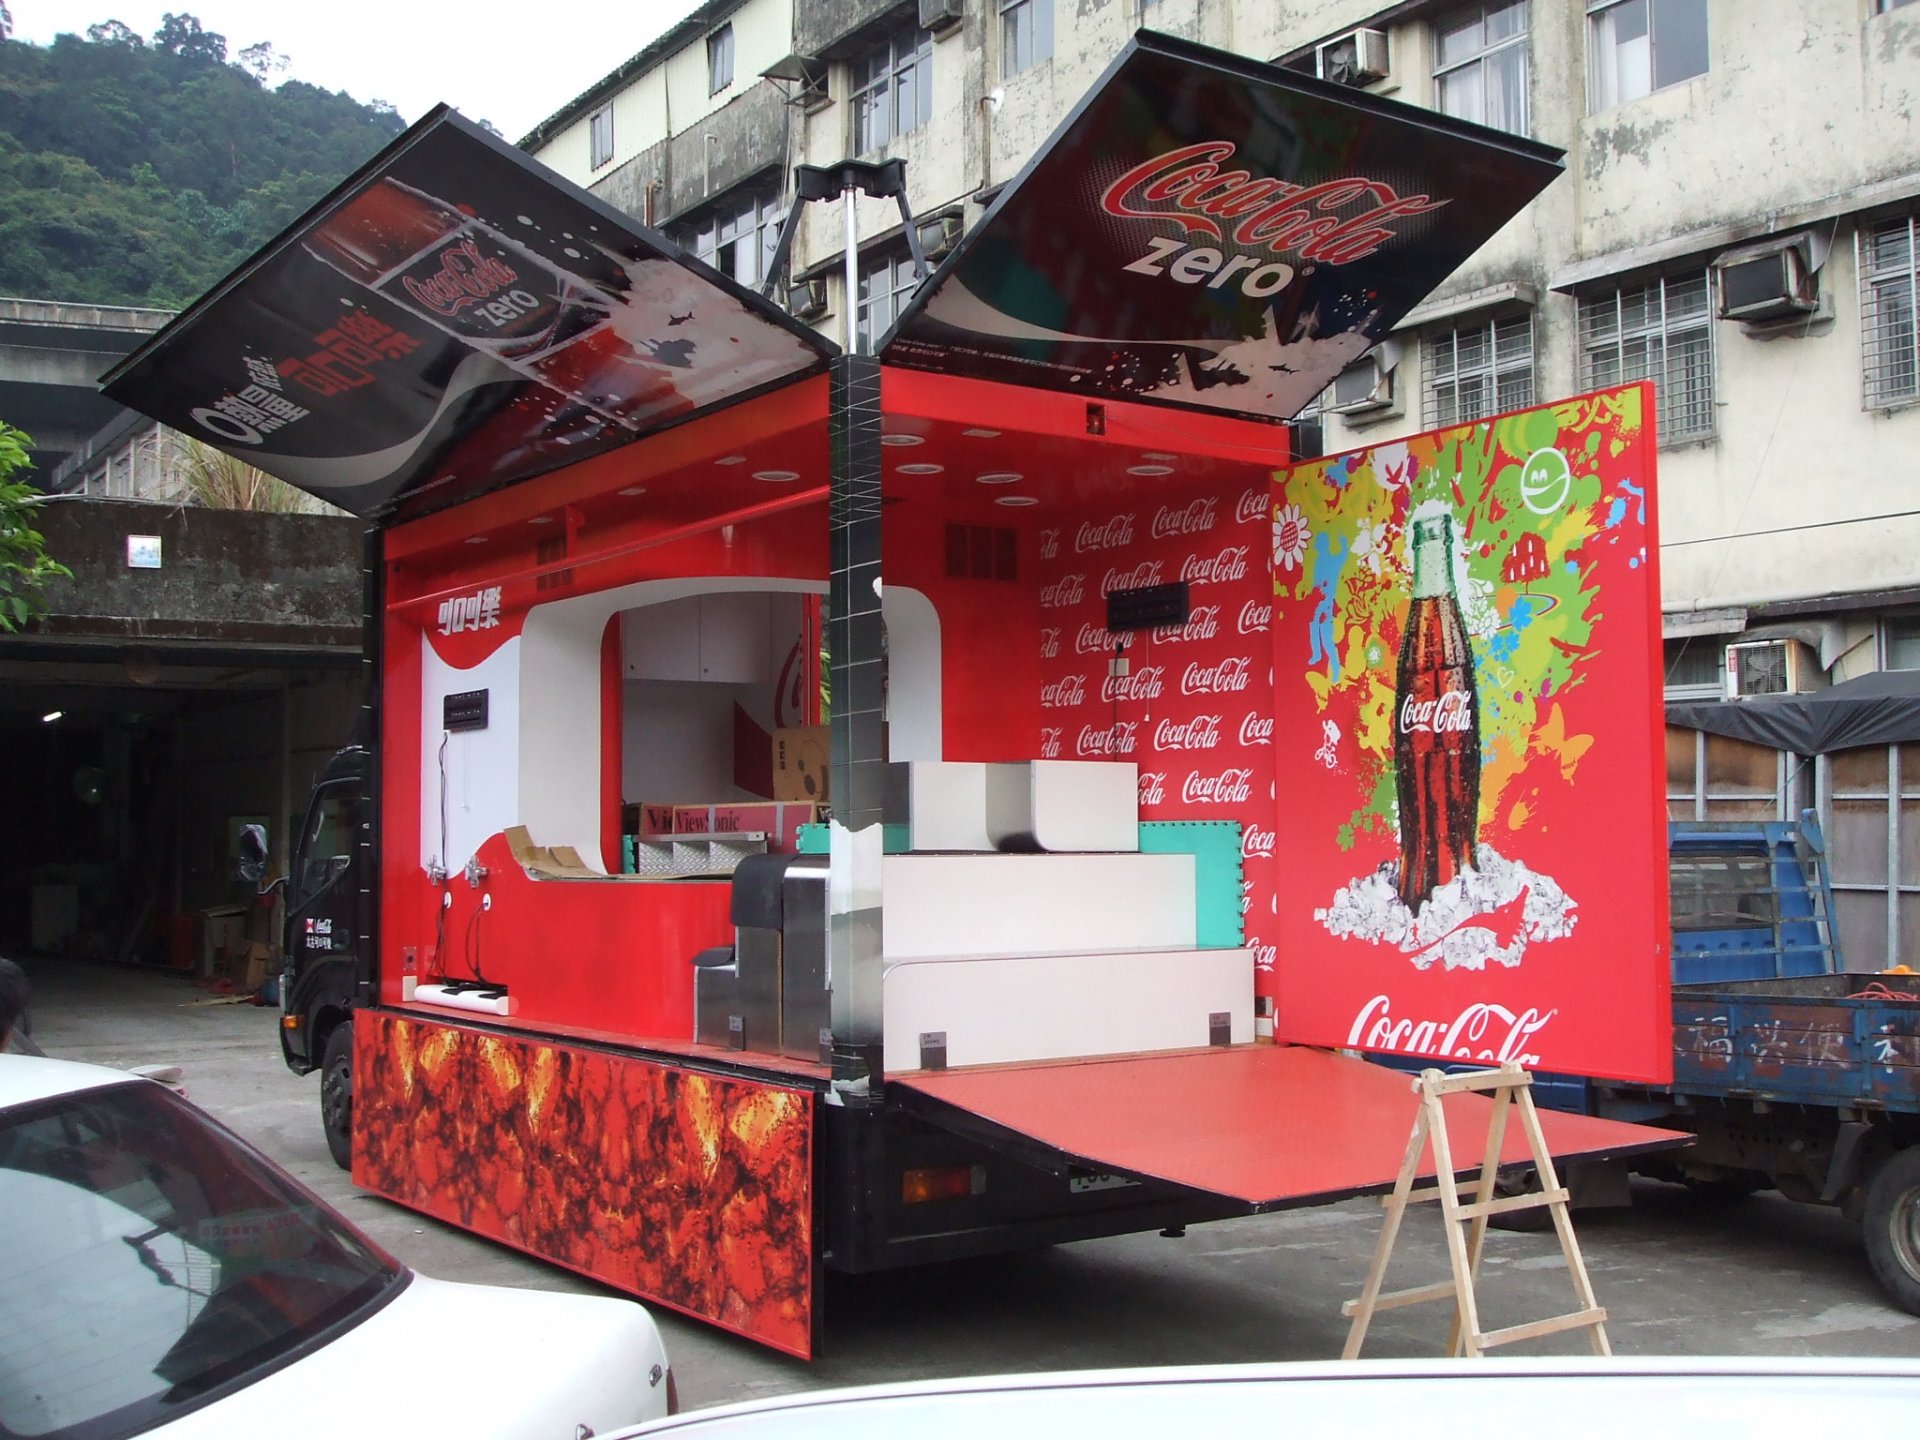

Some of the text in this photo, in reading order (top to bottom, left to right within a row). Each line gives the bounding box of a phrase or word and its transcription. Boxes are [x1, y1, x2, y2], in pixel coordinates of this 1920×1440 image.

[1101, 141, 1453, 266] Coca-Cola
[402, 240, 518, 317] Coca-Cola
[1122, 236, 1294, 298] zero
[473, 289, 540, 327] zero
[1075, 513, 1136, 553] Coca-Cola
[1152, 497, 1219, 539] Coca-Cola
[1180, 545, 1250, 586] Coca-Cola
[1181, 657, 1252, 696] Coca-Cola
[1401, 690, 1472, 734] Coca-Cola
[1154, 715, 1222, 751] Coca-Cola
[1182, 768, 1253, 804] Coca-Cola
